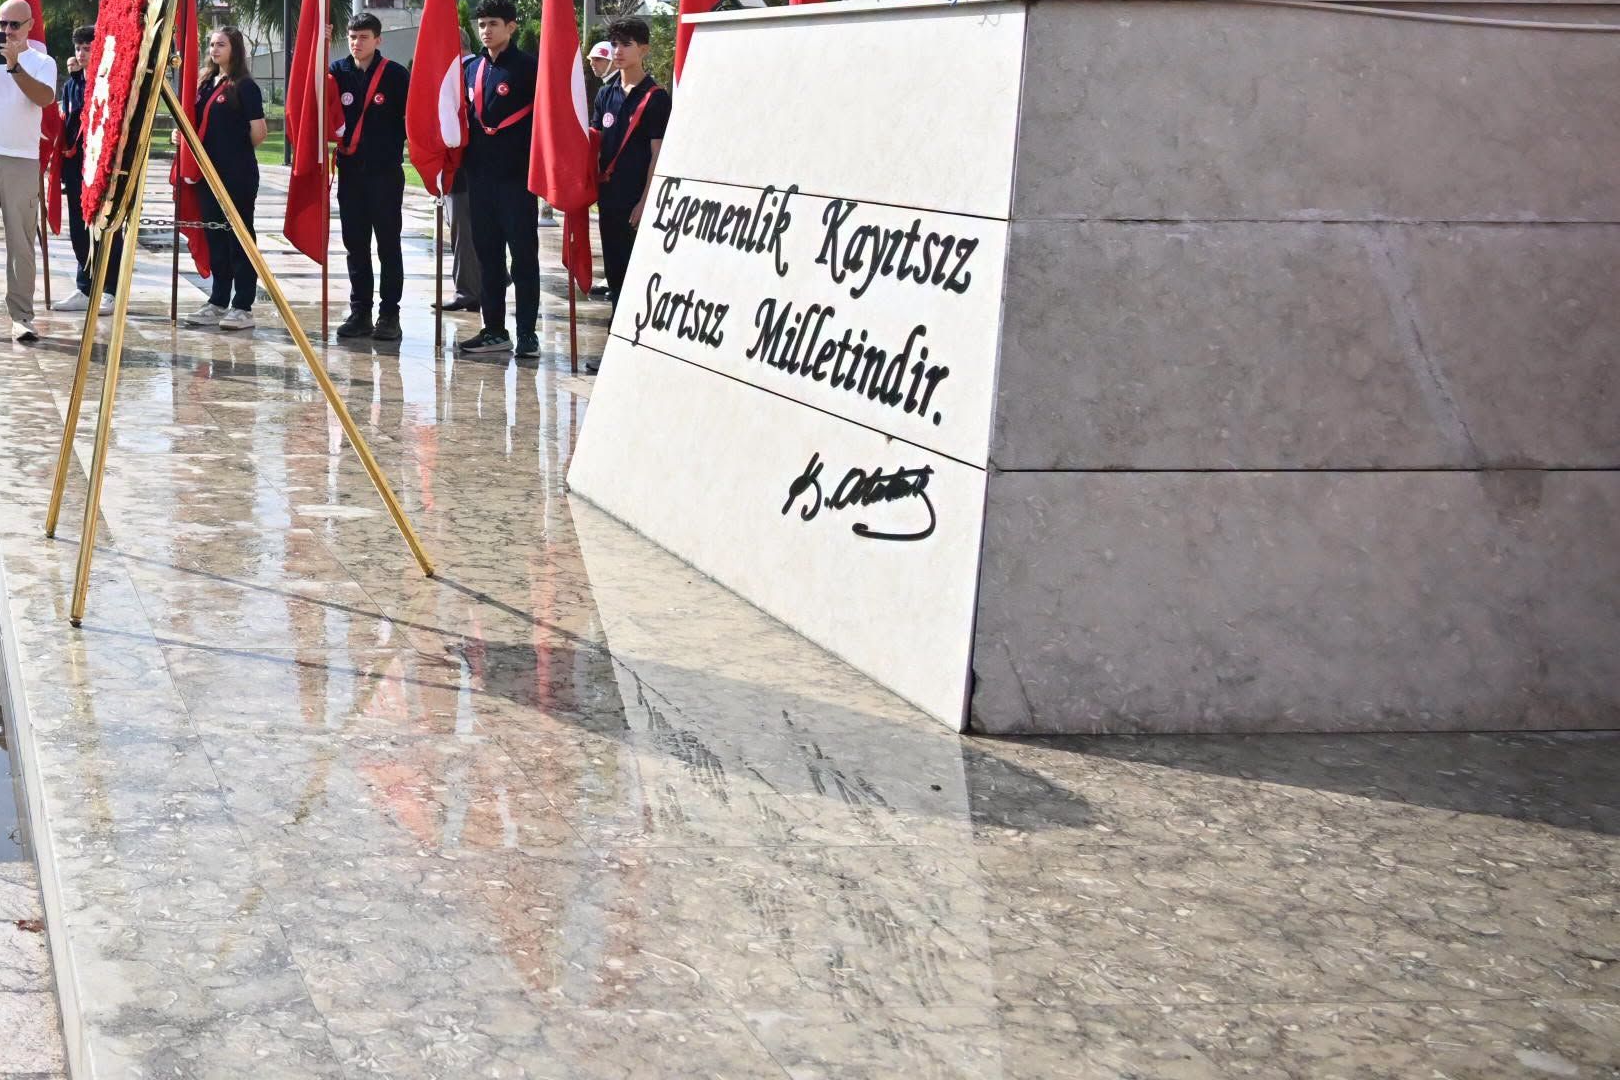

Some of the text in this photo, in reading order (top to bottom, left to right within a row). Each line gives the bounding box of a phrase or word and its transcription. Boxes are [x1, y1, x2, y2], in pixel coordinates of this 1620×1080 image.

[652, 176, 979, 299] Egemenlik Kayıtsız
[631, 272, 730, 348] Şartsız
